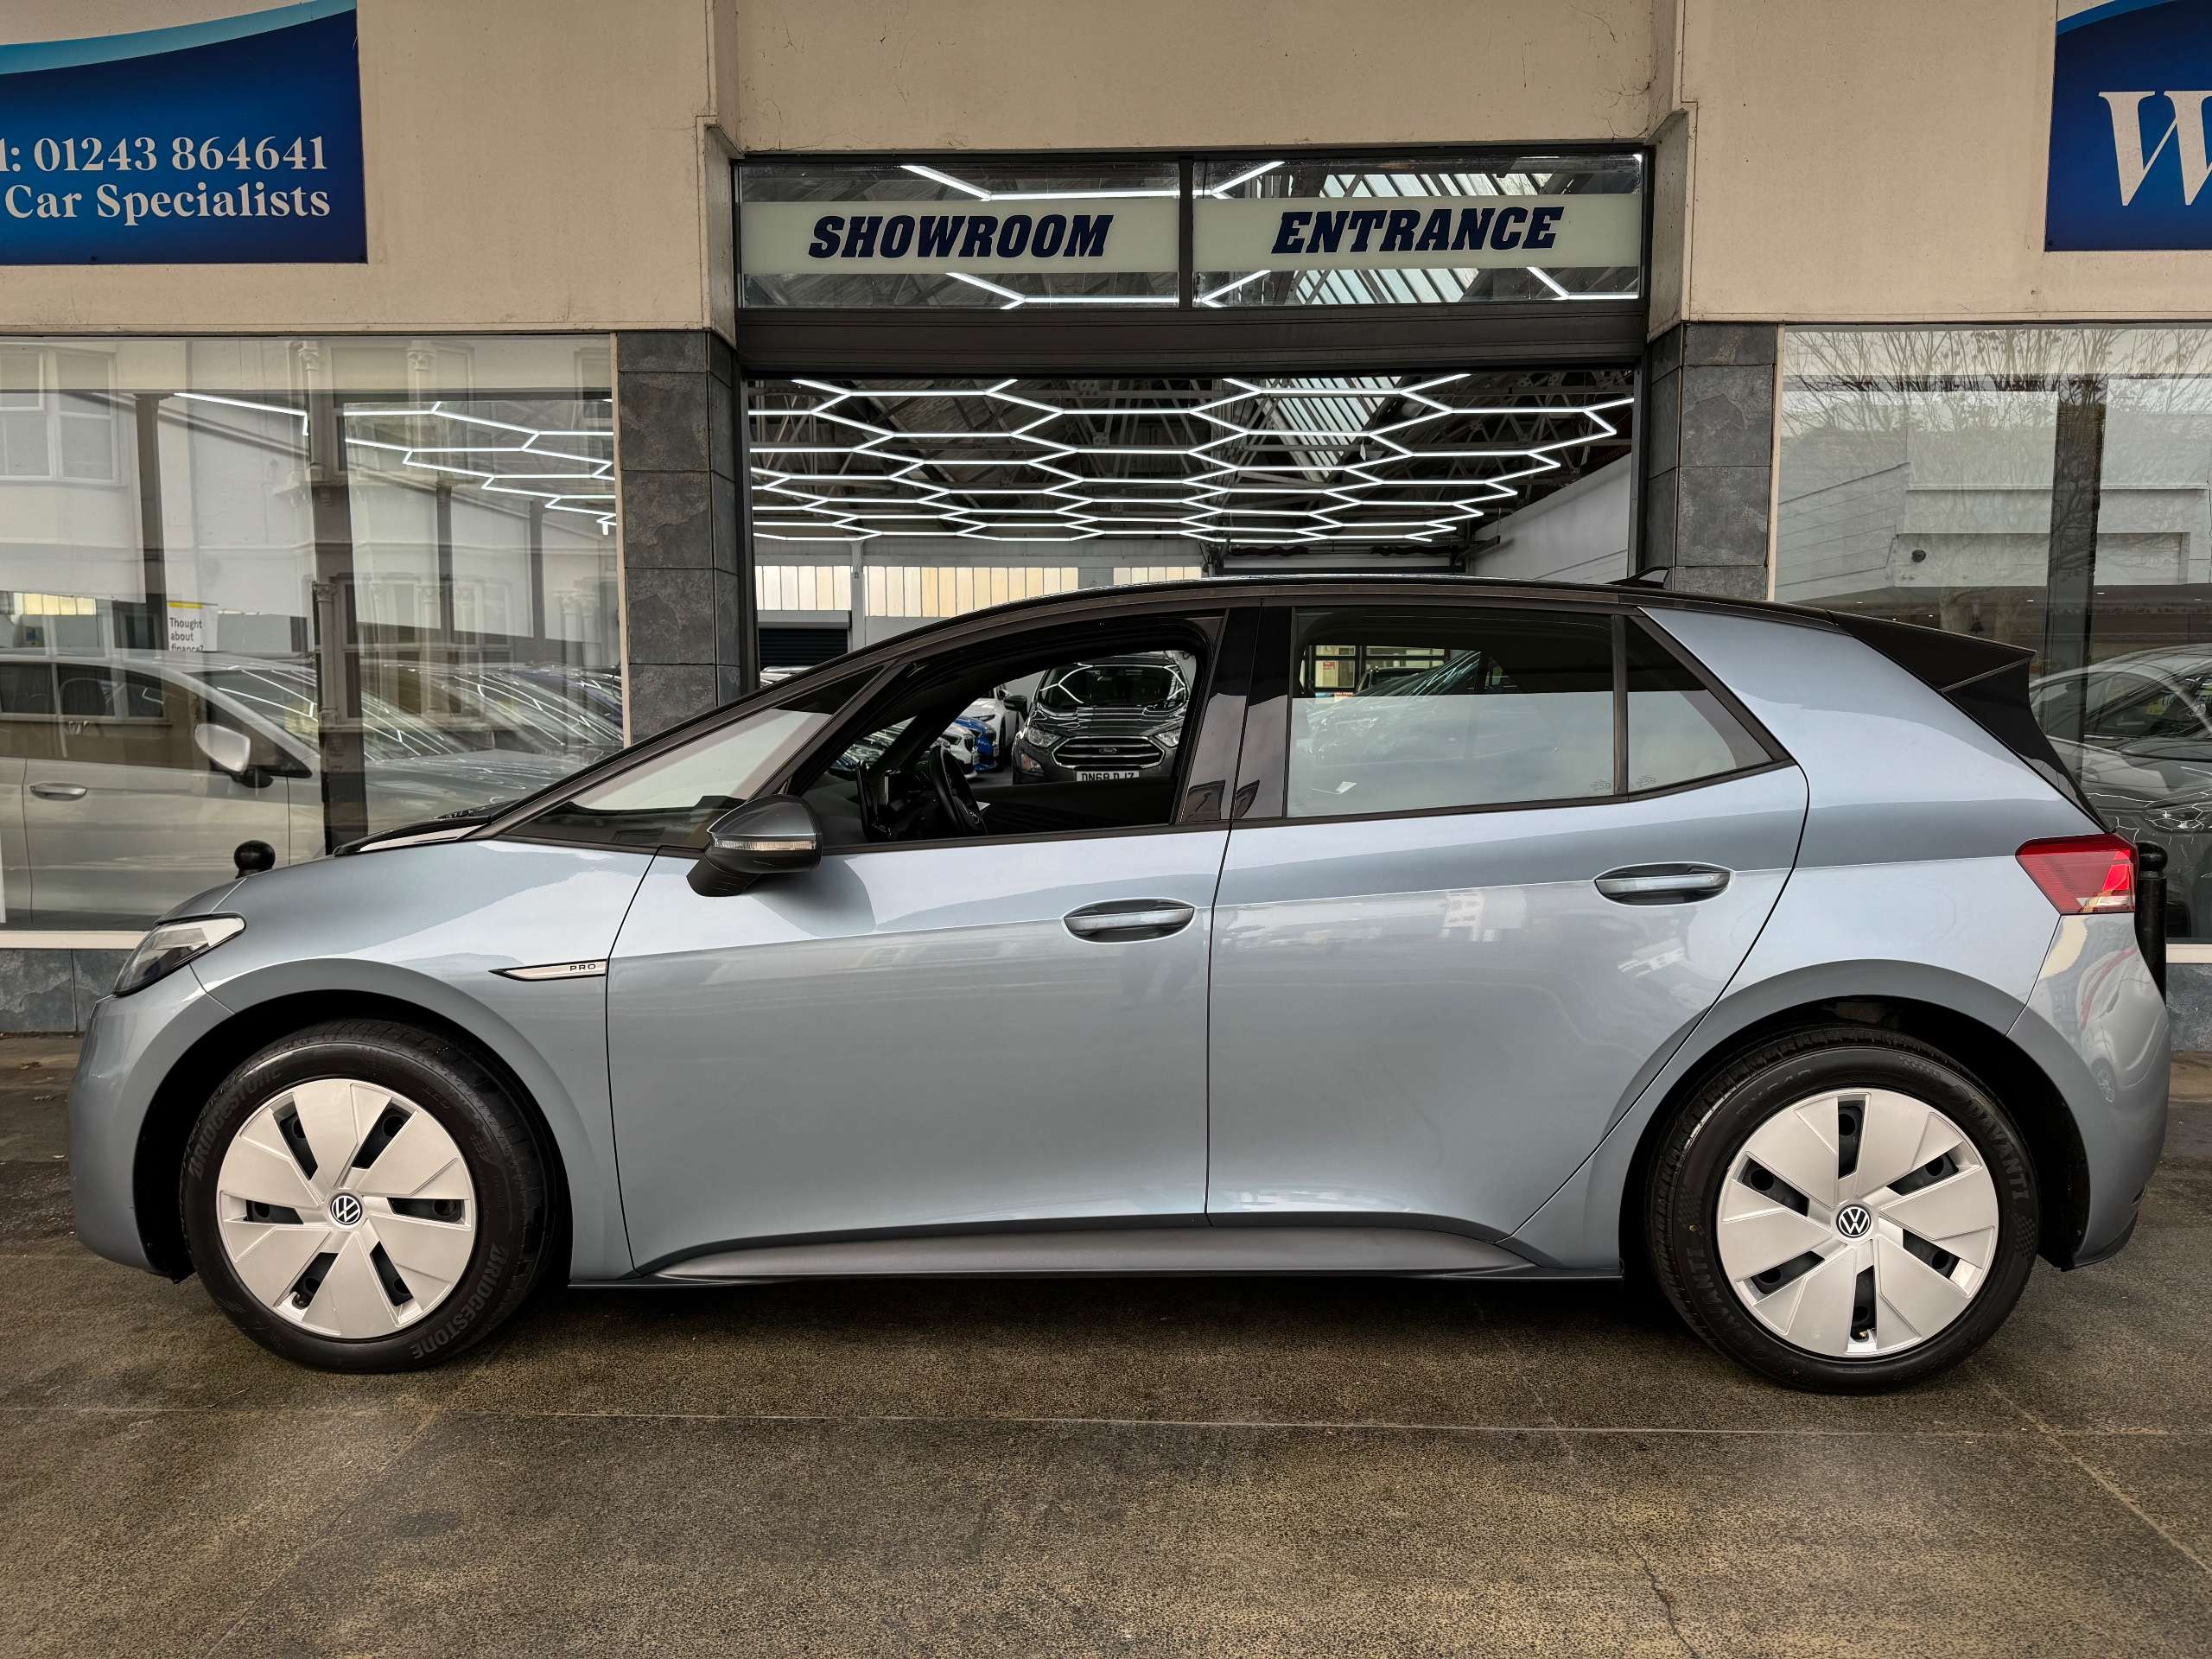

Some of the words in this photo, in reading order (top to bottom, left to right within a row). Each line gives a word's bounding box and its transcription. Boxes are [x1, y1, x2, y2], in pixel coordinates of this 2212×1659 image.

[34, 137, 157, 172] 01243
[172, 136, 327, 170] 864641
[2098, 90, 2212, 207] W
[5, 184, 82, 218] Car
[96, 181, 330, 226] Specialists
[808, 213, 1114, 258] SHOWROOM
[1270, 207, 1565, 254] ENTRANCE
[169, 617, 202, 630] Thought
[170, 631, 194, 641] about
[409, 1242, 510, 1360] BRIDGESTONE
